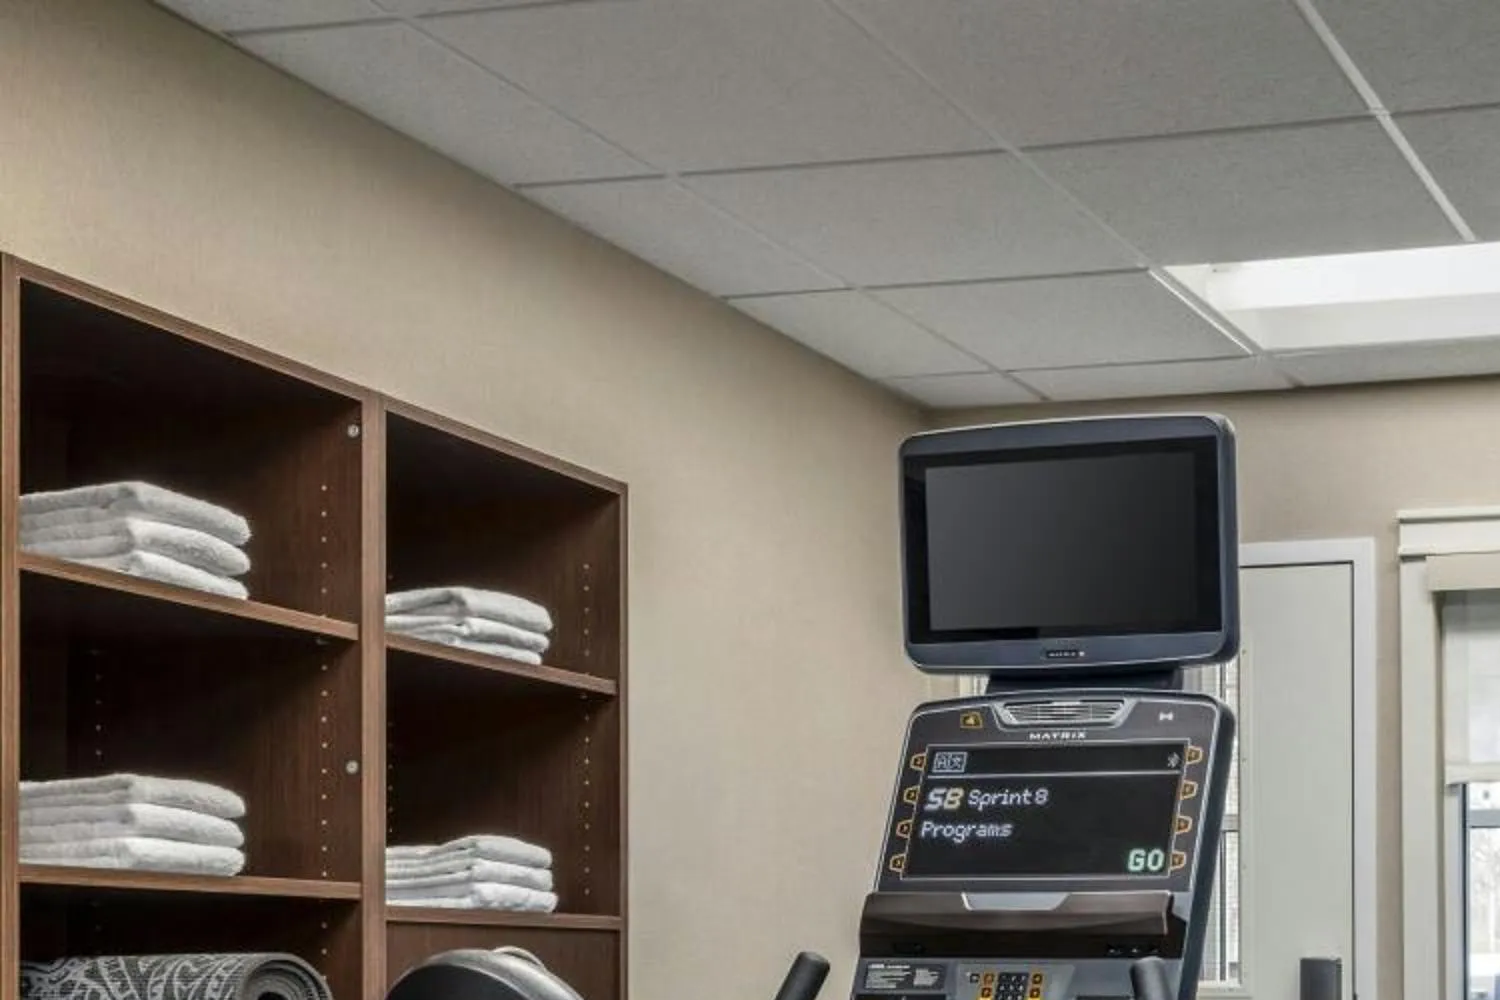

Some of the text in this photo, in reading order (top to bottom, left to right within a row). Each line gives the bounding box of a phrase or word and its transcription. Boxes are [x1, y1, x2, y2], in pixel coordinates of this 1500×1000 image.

[1029, 731, 1086, 741] MATRIX
[921, 821, 1013, 843] Programs
[1128, 848, 1165, 872] GO
